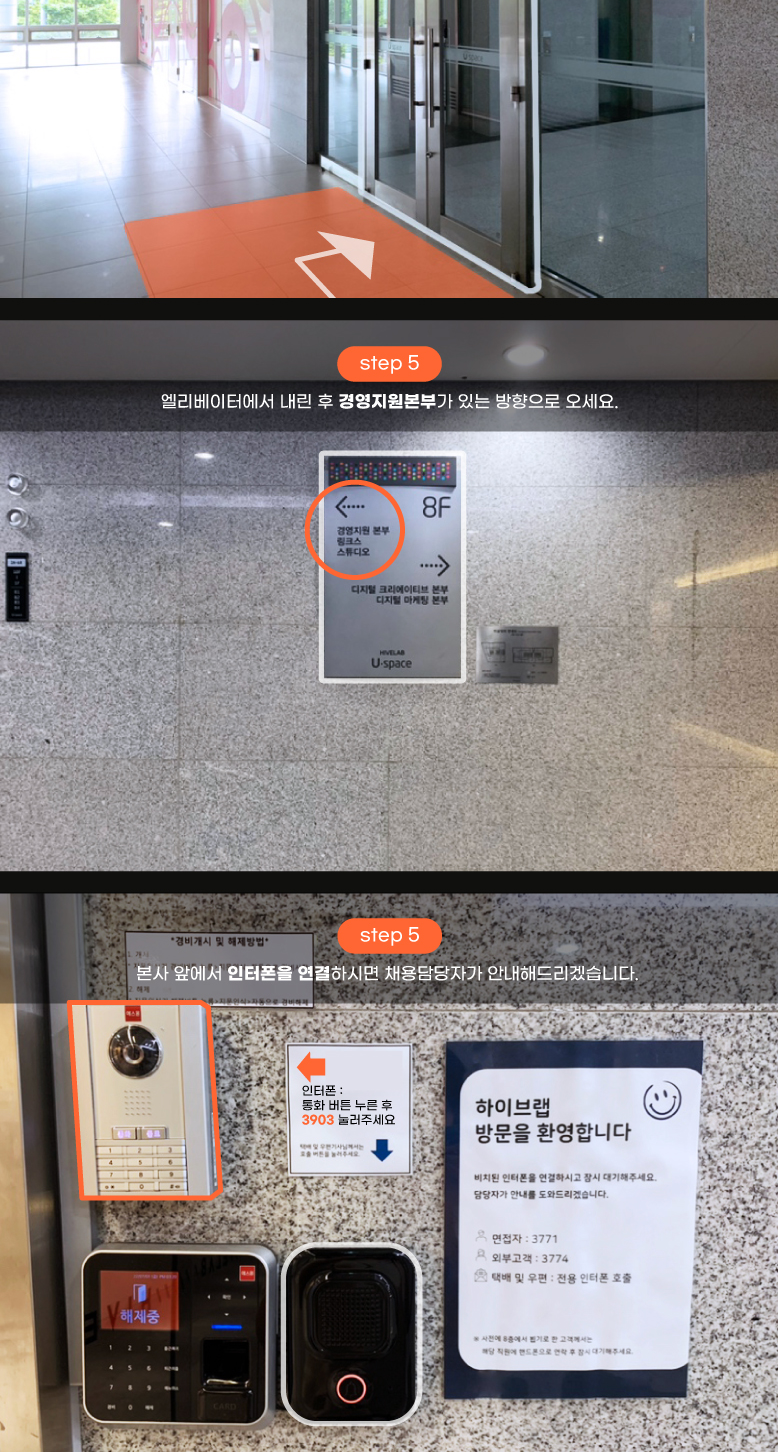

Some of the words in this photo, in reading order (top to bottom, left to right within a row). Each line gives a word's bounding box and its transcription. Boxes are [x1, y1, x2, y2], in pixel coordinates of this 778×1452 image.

[422, 496, 451, 519] 8F
[337, 525, 370, 536] 경영지원
[372, 526, 390, 536] 본부
[336, 536, 362, 547] 링크스
[336, 547, 371, 557] 스튜디오
[351, 584, 376, 595] 디지털
[379, 584, 429, 595] 크리에이티브
[432, 584, 449, 595] 본부
[301, 1084, 337, 1097] 인터폰
[301, 1099, 326, 1111] 통화
[328, 1099, 352, 1111] 버튼
[354, 1099, 378, 1112] 누른
[381, 1099, 393, 1112] 후
[475, 1097, 550, 1119] 하이브랩
[301, 1113, 335, 1126] 3903
[338, 1113, 396, 1126] 눌러주세요
[475, 1123, 531, 1144] 방문을
[536, 1122, 632, 1144] 환영합니다
[492, 1233, 523, 1245] 면접자
[531, 1234, 558, 1244] 3771
[492, 1253, 532, 1264] 외부고객
[541, 1254, 569, 1264] 3774
[120, 1309, 160, 1325] 해제중
[213, 1402, 237, 1410] CARD
